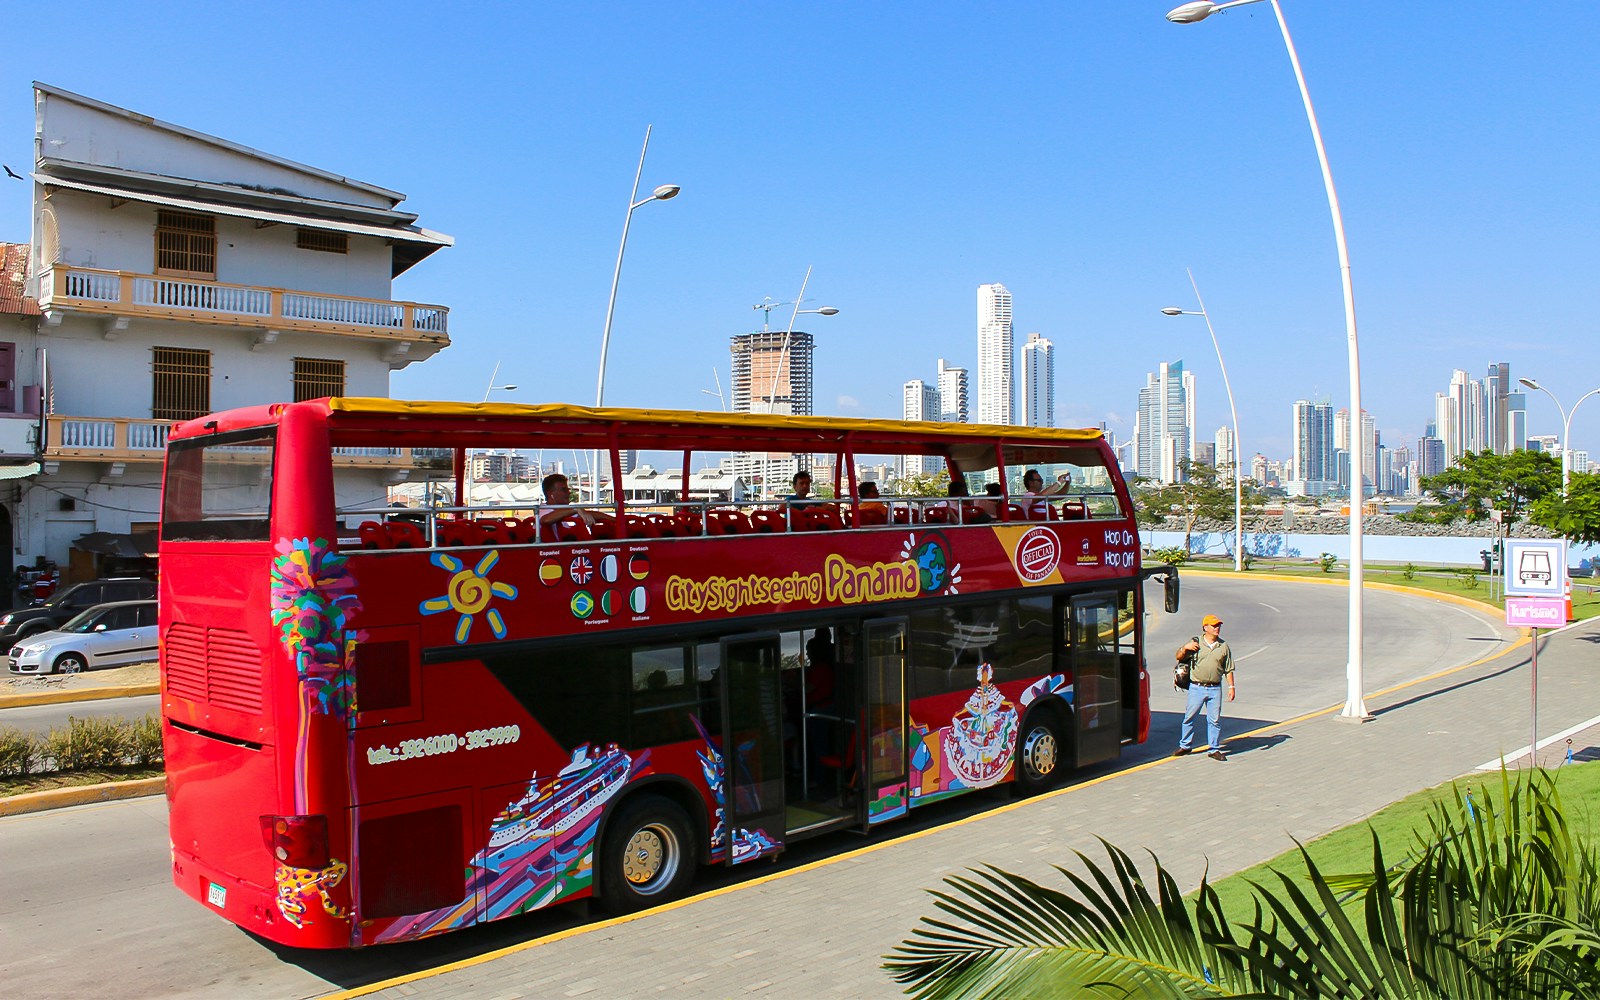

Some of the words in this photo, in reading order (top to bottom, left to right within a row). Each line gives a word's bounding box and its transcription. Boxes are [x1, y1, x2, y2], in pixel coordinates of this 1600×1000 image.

[1104, 530, 1120, 546] Hop
[1122, 530, 1134, 546] On
[1023, 545, 1053, 564] OFFICIAL
[1104, 551, 1120, 567] Hop
[1122, 551, 1135, 568] Off
[825, 553, 921, 604] Panama
[1025, 572, 1034, 580] OF
[1034, 562, 1055, 580] PANAMA
[1510, 604, 1558, 619] Turismo
